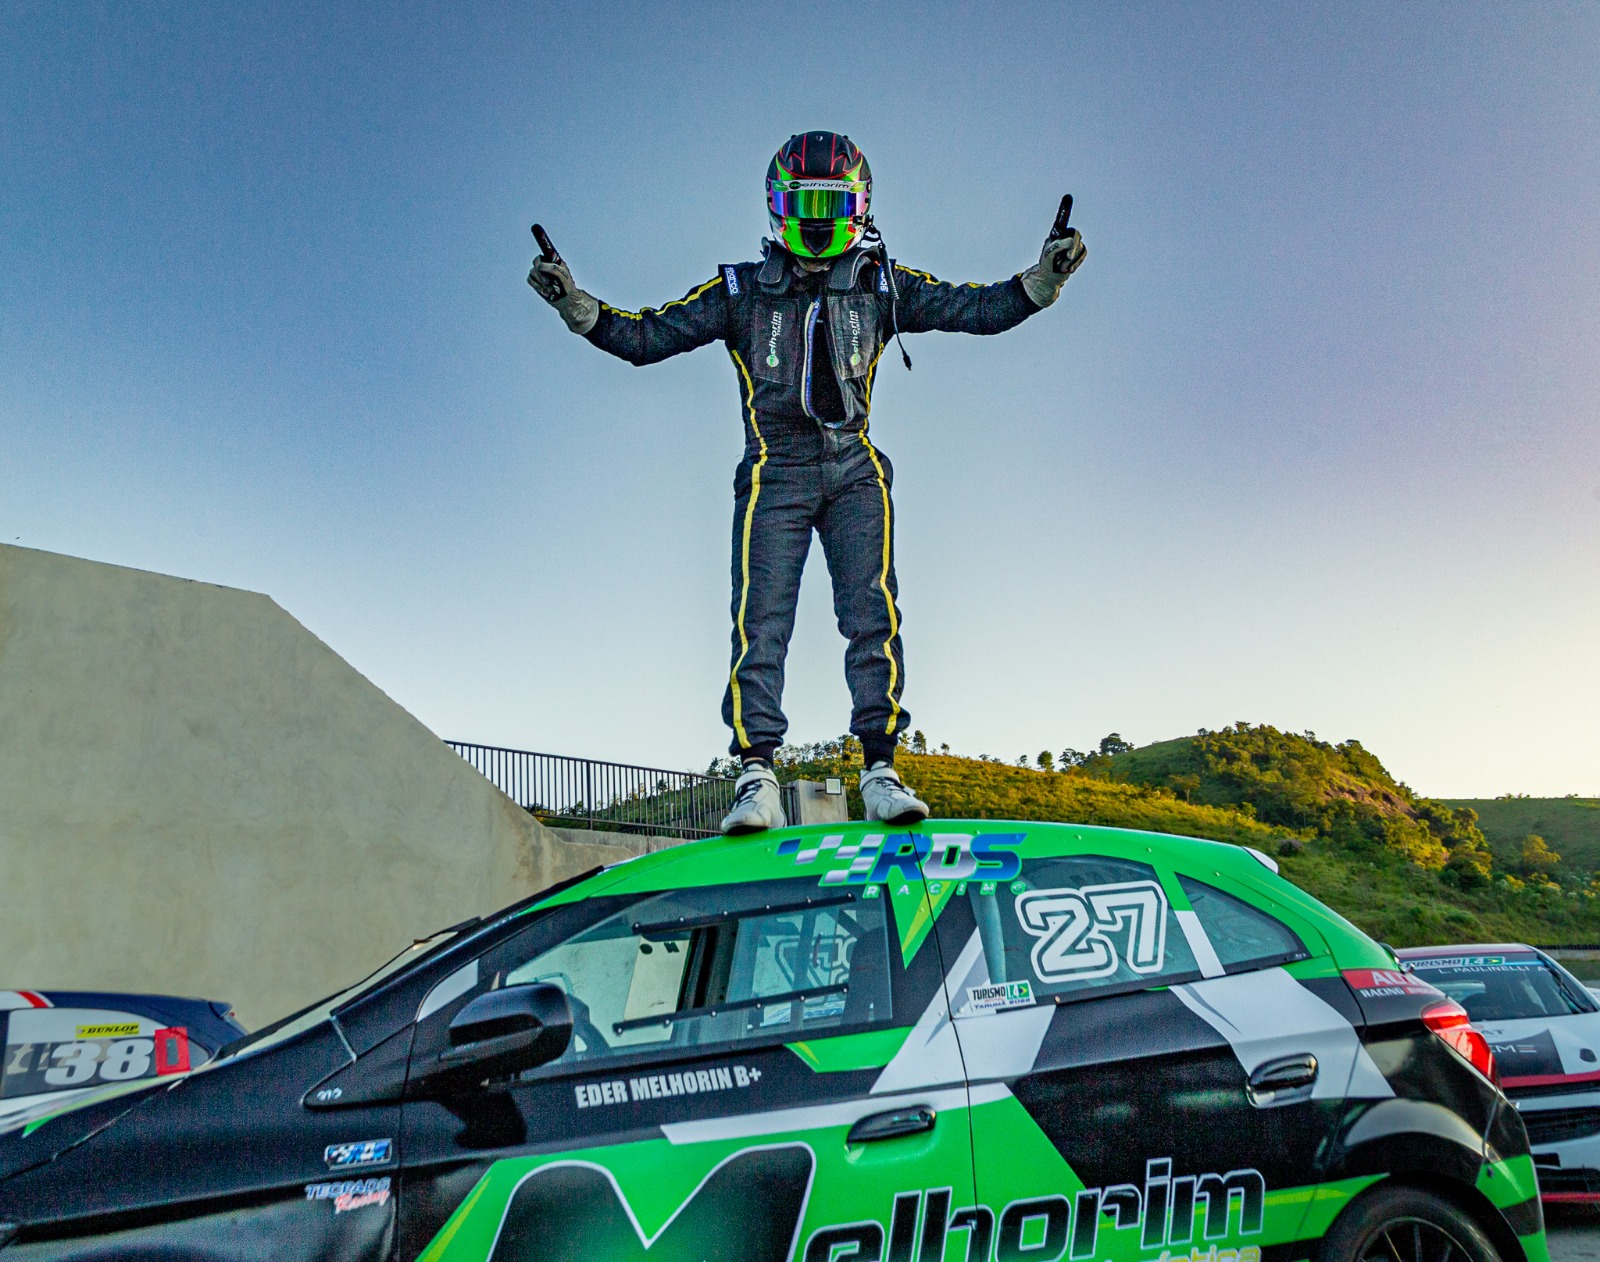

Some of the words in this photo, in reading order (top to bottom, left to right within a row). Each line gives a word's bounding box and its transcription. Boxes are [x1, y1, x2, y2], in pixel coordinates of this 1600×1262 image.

[868, 832, 1028, 882] RDS
[1015, 879, 1168, 984] 27
[1404, 957, 1461, 969] TURISMO
[1453, 965, 1530, 974] PAULINELLI
[972, 986, 1006, 1001] TURISMO
[1006, 984, 1019, 1000] 1.4
[1360, 986, 1405, 998] RACING
[87, 1024, 139, 1034] DUNLOP
[45, 1039, 155, 1086] 38
[574, 1080, 629, 1108] EDER
[629, 1067, 733, 1101] MELHORIN
[733, 1065, 762, 1088] B+
